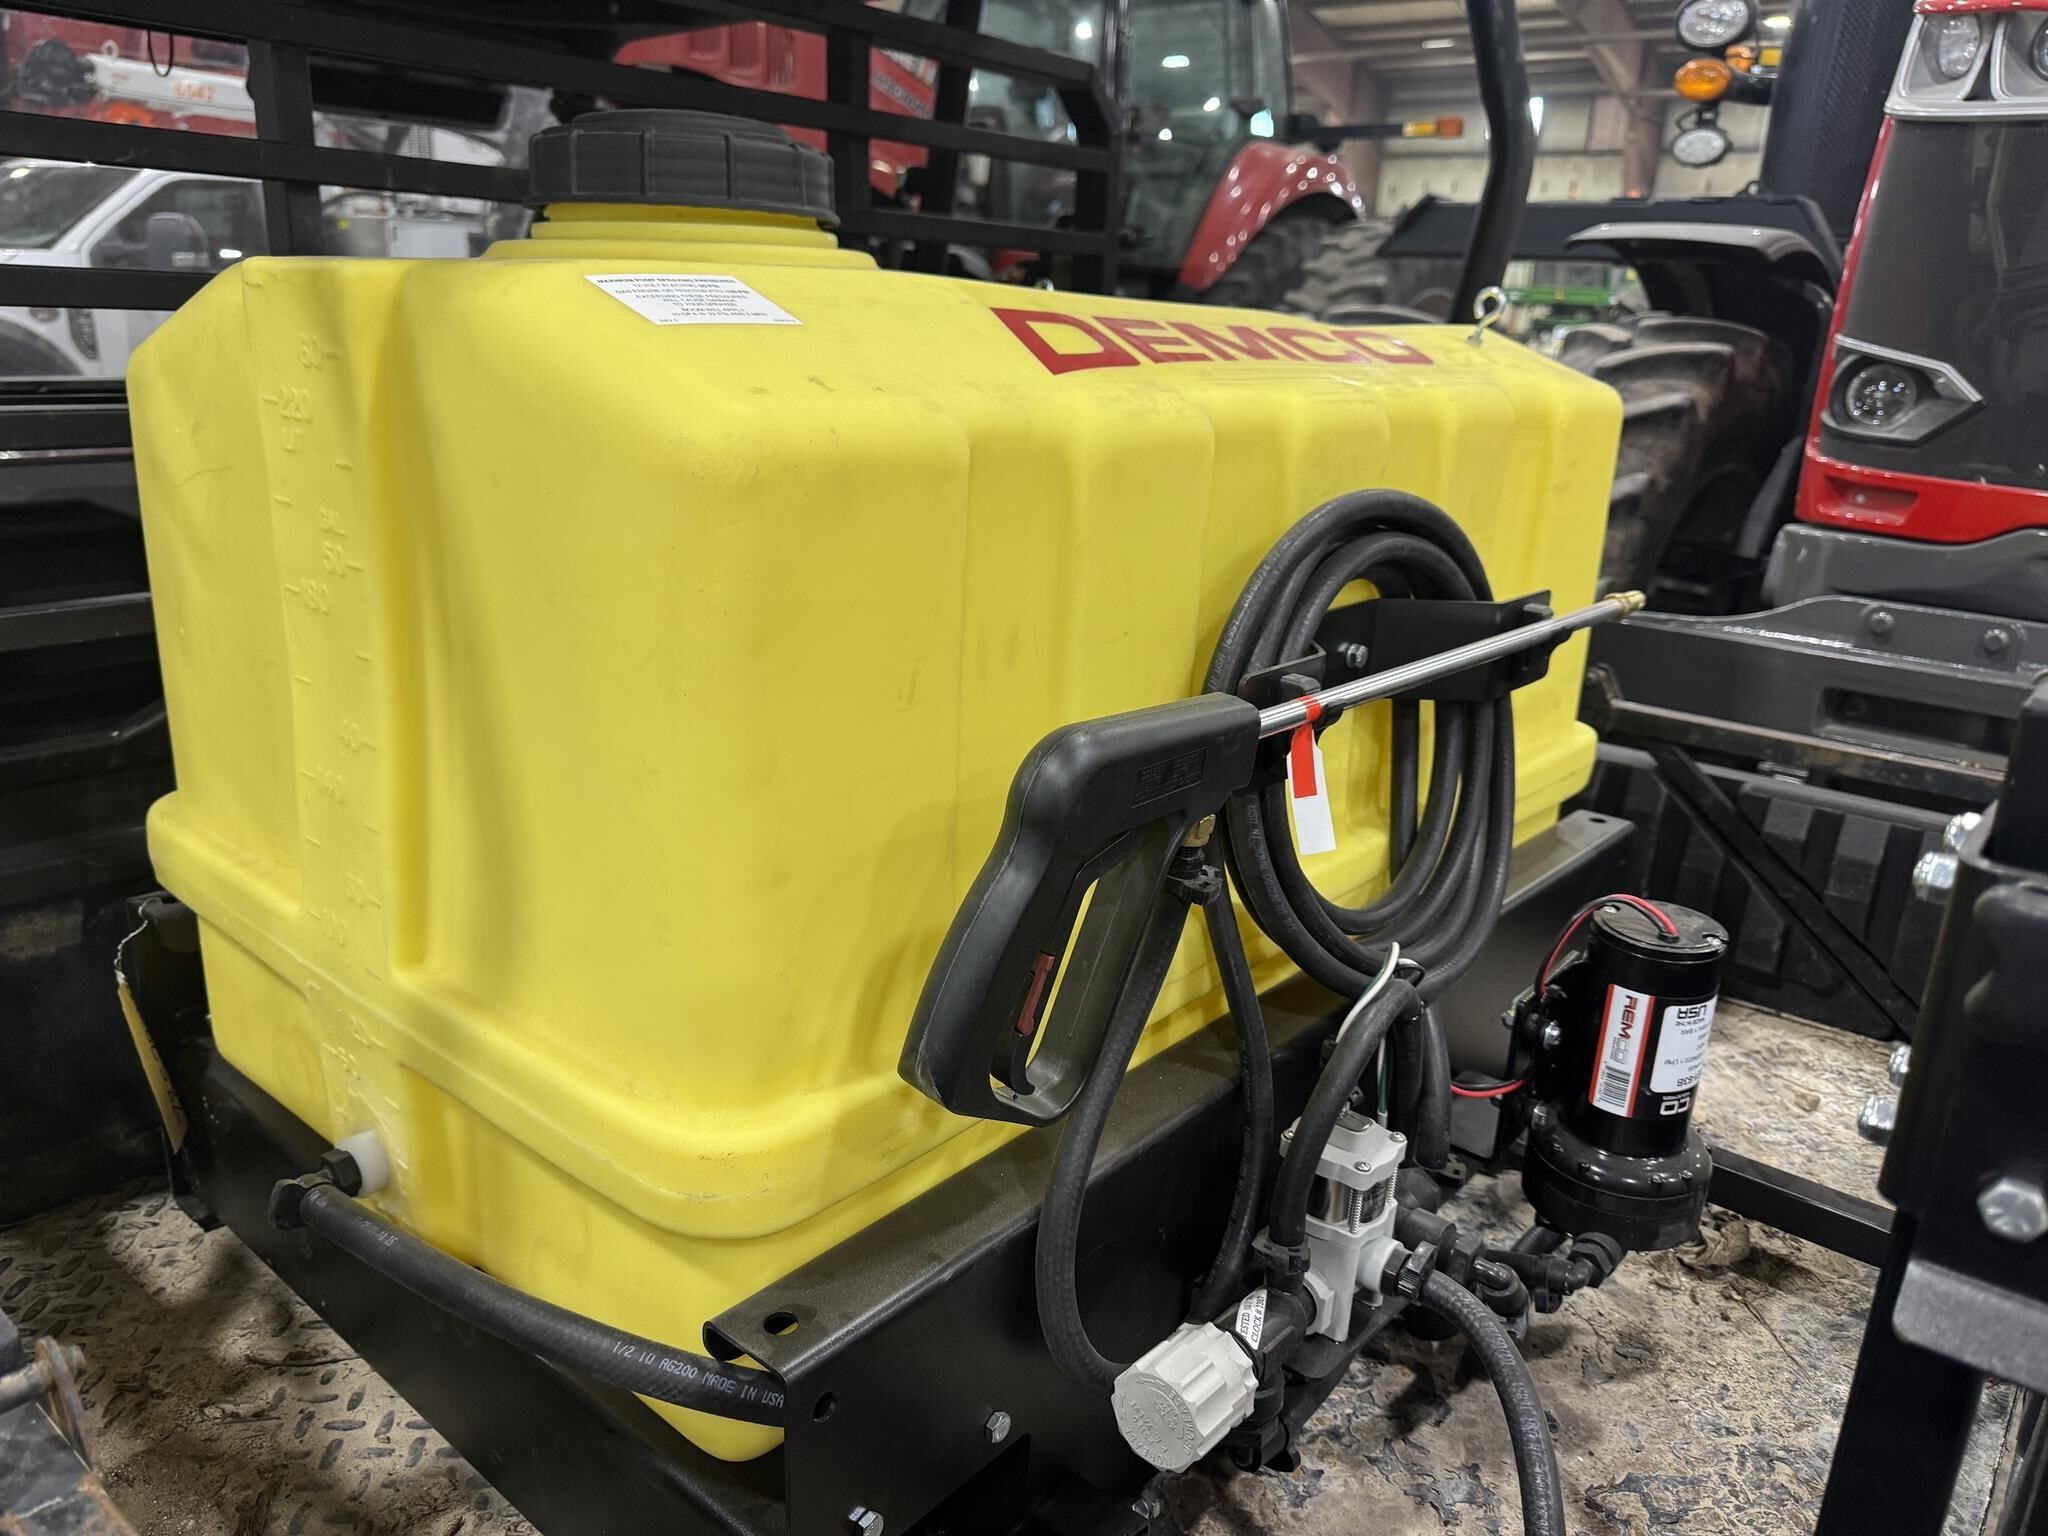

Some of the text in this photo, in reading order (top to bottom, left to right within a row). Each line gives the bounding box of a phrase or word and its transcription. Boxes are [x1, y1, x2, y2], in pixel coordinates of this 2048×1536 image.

[990, 307, 1434, 376] DEMCO
[1677, 1005, 1707, 1020] USA
[1614, 995, 1639, 1064] REMCO
[1241, 1312, 1251, 1339] ESTED
[1251, 1315, 1262, 1342] CLOCK
[702, 1372, 737, 1394] MADE
[740, 1384, 757, 1401] IN
[761, 1391, 786, 1408] USA
